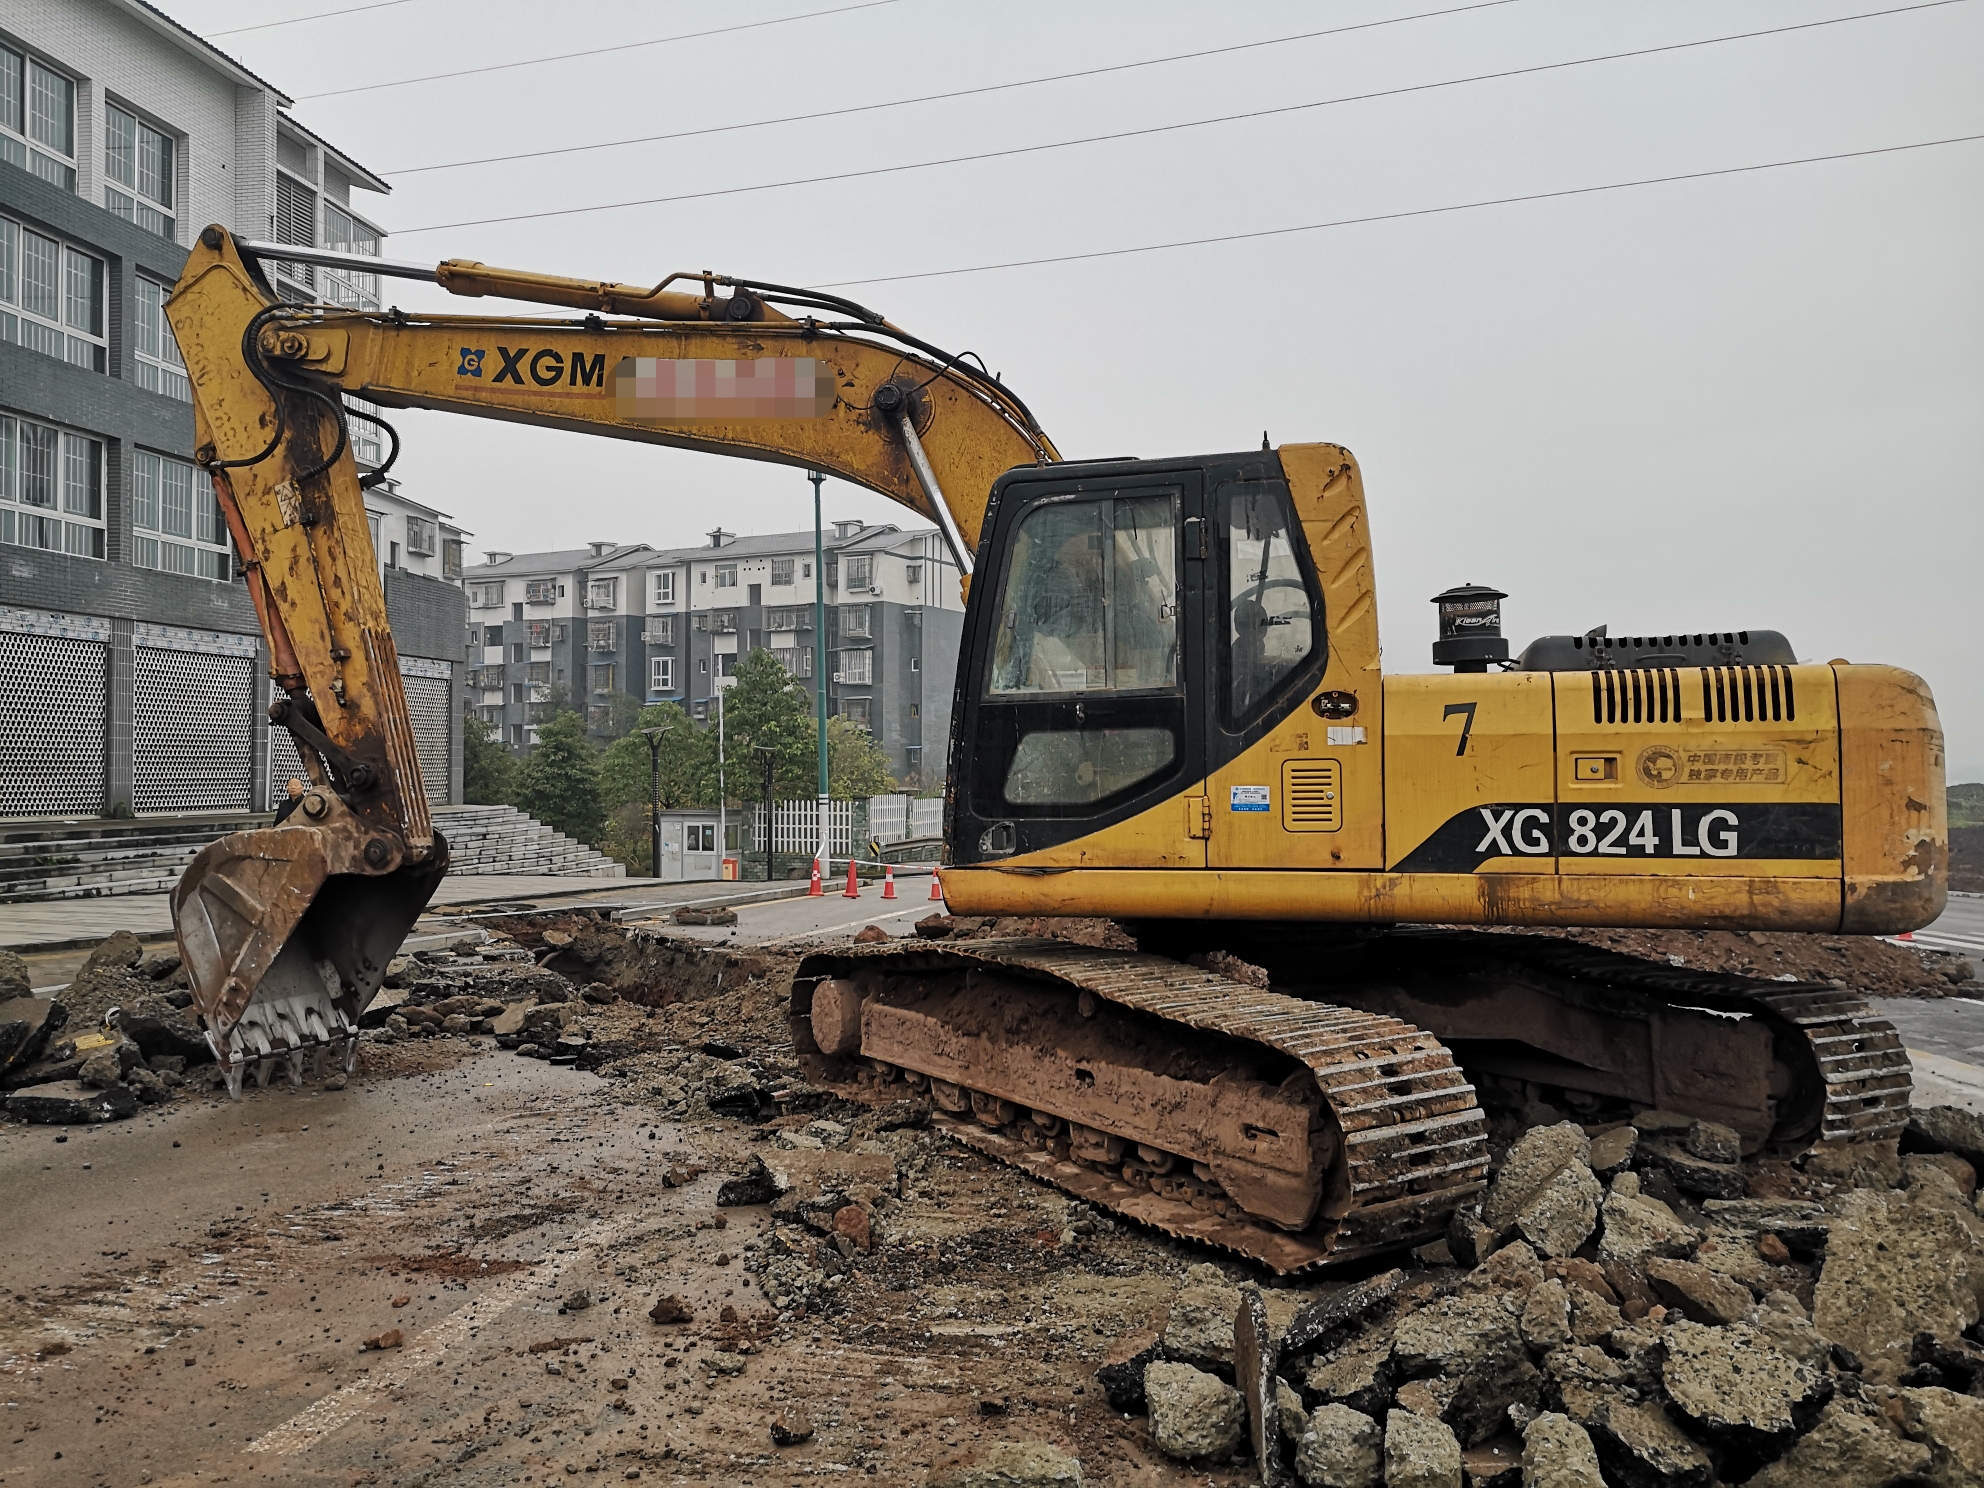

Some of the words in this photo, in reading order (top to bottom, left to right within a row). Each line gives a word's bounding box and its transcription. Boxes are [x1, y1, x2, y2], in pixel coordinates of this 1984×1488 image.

[491, 346, 631, 388] XGM
[1443, 702, 1477, 756] 7
[1475, 808, 1550, 854] XG
[1568, 809, 1660, 854] 824
[1671, 808, 1740, 857] LG
